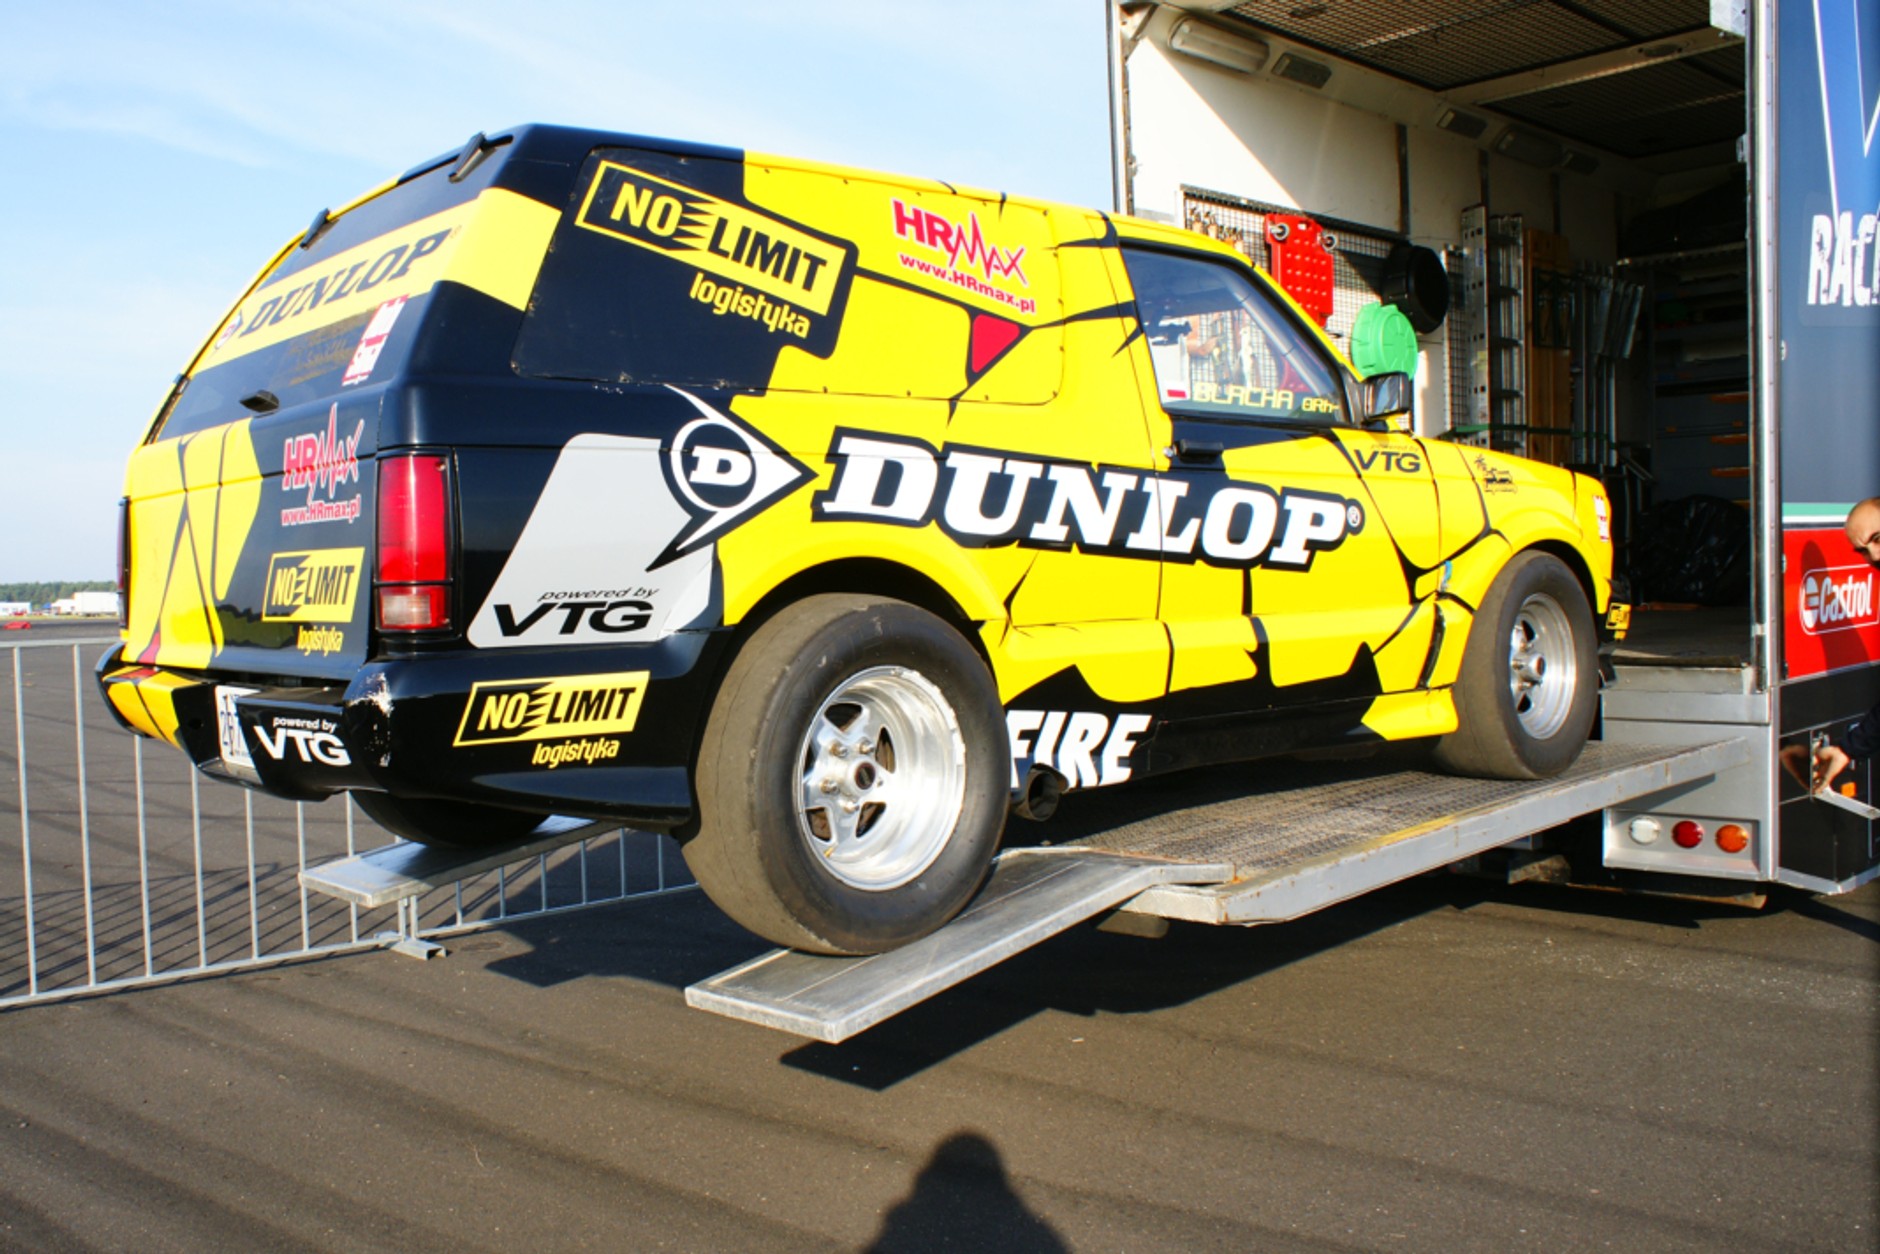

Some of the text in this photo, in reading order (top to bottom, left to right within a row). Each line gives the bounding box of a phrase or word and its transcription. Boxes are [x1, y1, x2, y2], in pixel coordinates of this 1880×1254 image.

[610, 181, 828, 293] NO LIMIT
[238, 228, 453, 338] DUNLOP
[900, 253, 1036, 313] www.HRmax.pl
[689, 272, 811, 338] logistyka
[1193, 381, 1294, 410] BLACHA
[1353, 449, 1421, 473] VTG
[271, 565, 355, 606] NO LIMIT
[537, 586, 660, 601] powered by
[1820, 572, 1873, 624] Castrol
[493, 600, 654, 637] VTG
[297, 625, 344, 657] logistyka
[273, 717, 337, 733] powered by
[477, 687, 637, 731] NO LIMIT
[253, 726, 351, 766] VTG
[532, 737, 620, 769] logistyka
[1006, 709, 1153, 788] FIRE
